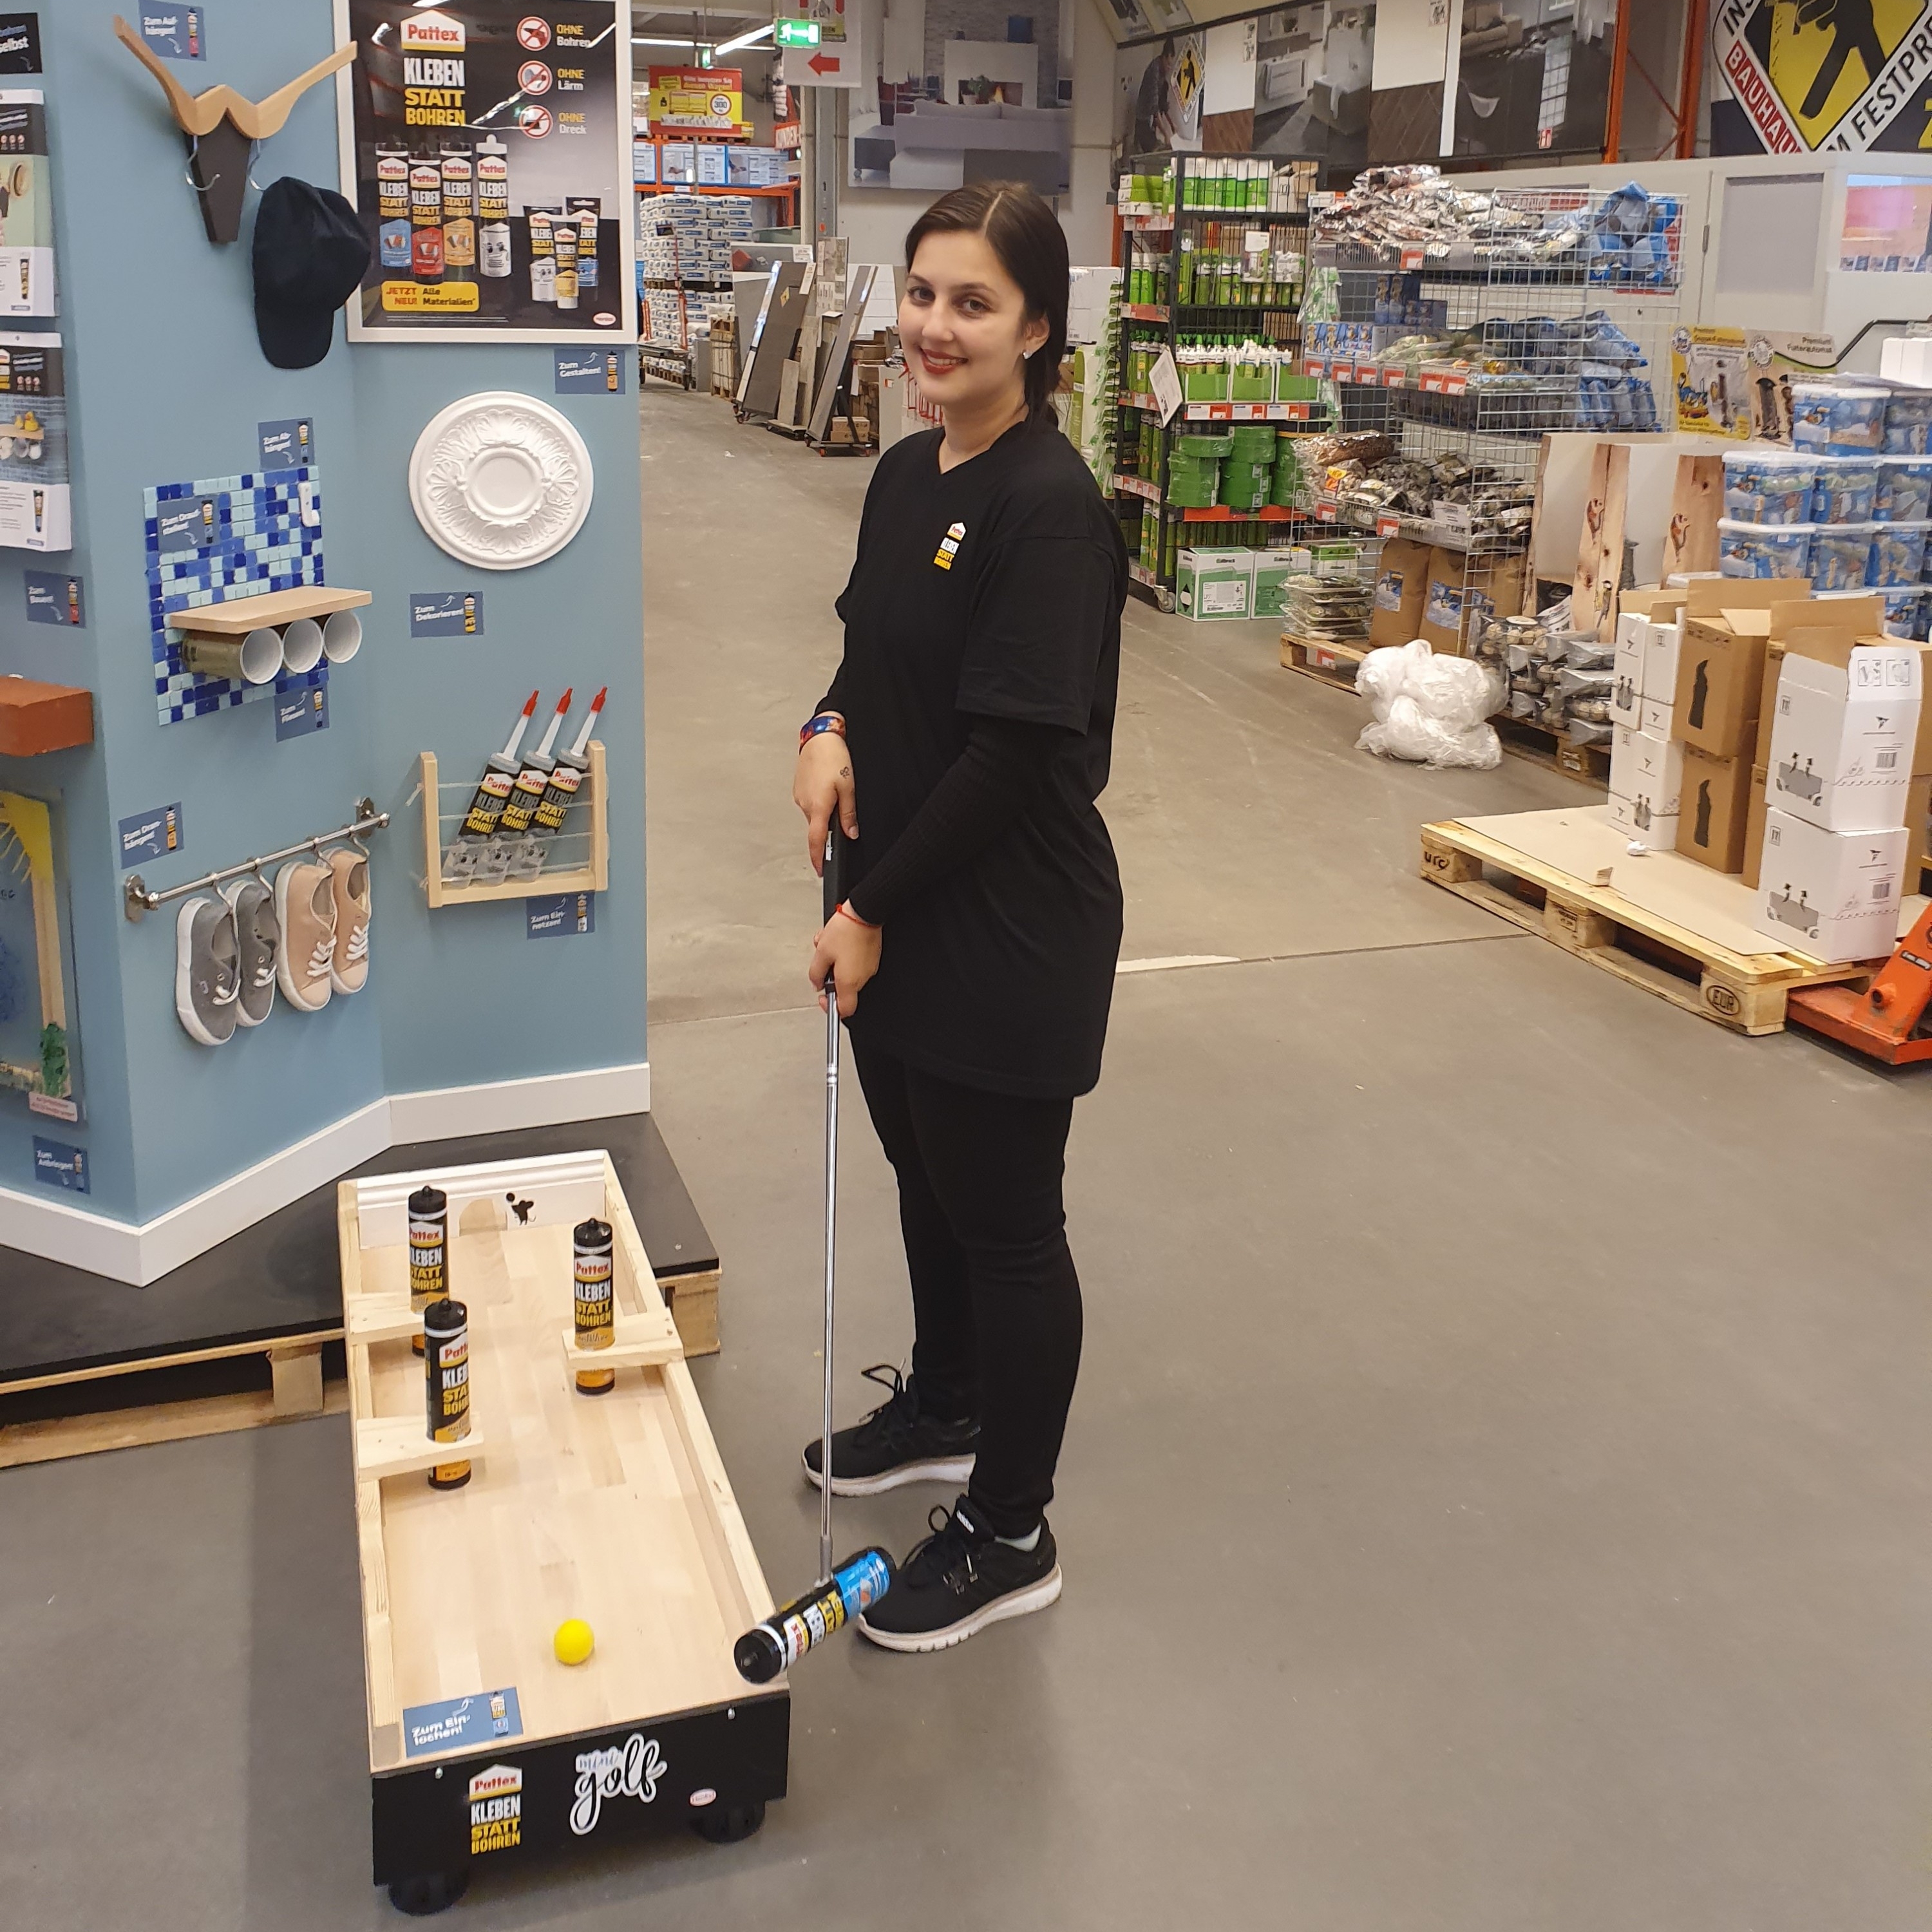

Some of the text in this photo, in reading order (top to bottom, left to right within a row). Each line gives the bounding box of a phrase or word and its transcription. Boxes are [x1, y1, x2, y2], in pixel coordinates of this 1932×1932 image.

[408, 24, 459, 41] Pattex
[556, 24, 583, 35] OHNE
[556, 36, 591, 46] Bohren
[404, 57, 465, 87] KLEBEN
[557, 68, 585, 79] OHNE
[558, 80, 583, 90] Lärm
[404, 88, 465, 107] STATT
[1728, 44, 1801, 153] BAUHAU
[406, 108, 466, 126] BOHREN
[558, 112, 585, 122] OHNE
[559, 124, 587, 134] Dreck
[386, 287, 440, 296] JETZT Alle
[414, 605, 435, 614] Zum
[554, 770, 578, 786] Patte
[466, 817, 496, 833] BOHRE
[531, 914, 550, 923] Zum
[410, 1231, 439, 1240] attex
[410, 1247, 442, 1266] LEBEN
[576, 1261, 609, 1274] Pattex
[575, 1279, 611, 1302] KLEBEN
[576, 1300, 610, 1315] STATT
[576, 1311, 611, 1327] BOHREN
[444, 1343, 468, 1360] Patt
[442, 1363, 468, 1390] KLEB
[443, 1385, 469, 1404] STA
[412, 1714, 471, 1738] Zum Ein-
[414, 1724, 463, 1747] lochen!
[475, 1776, 517, 1792] Pattex
[574, 1738, 666, 1830] golf
[471, 1794, 520, 1826] KLEBEN
[471, 1817, 521, 1841] STATT
[471, 1830, 520, 1855] BOHREN
